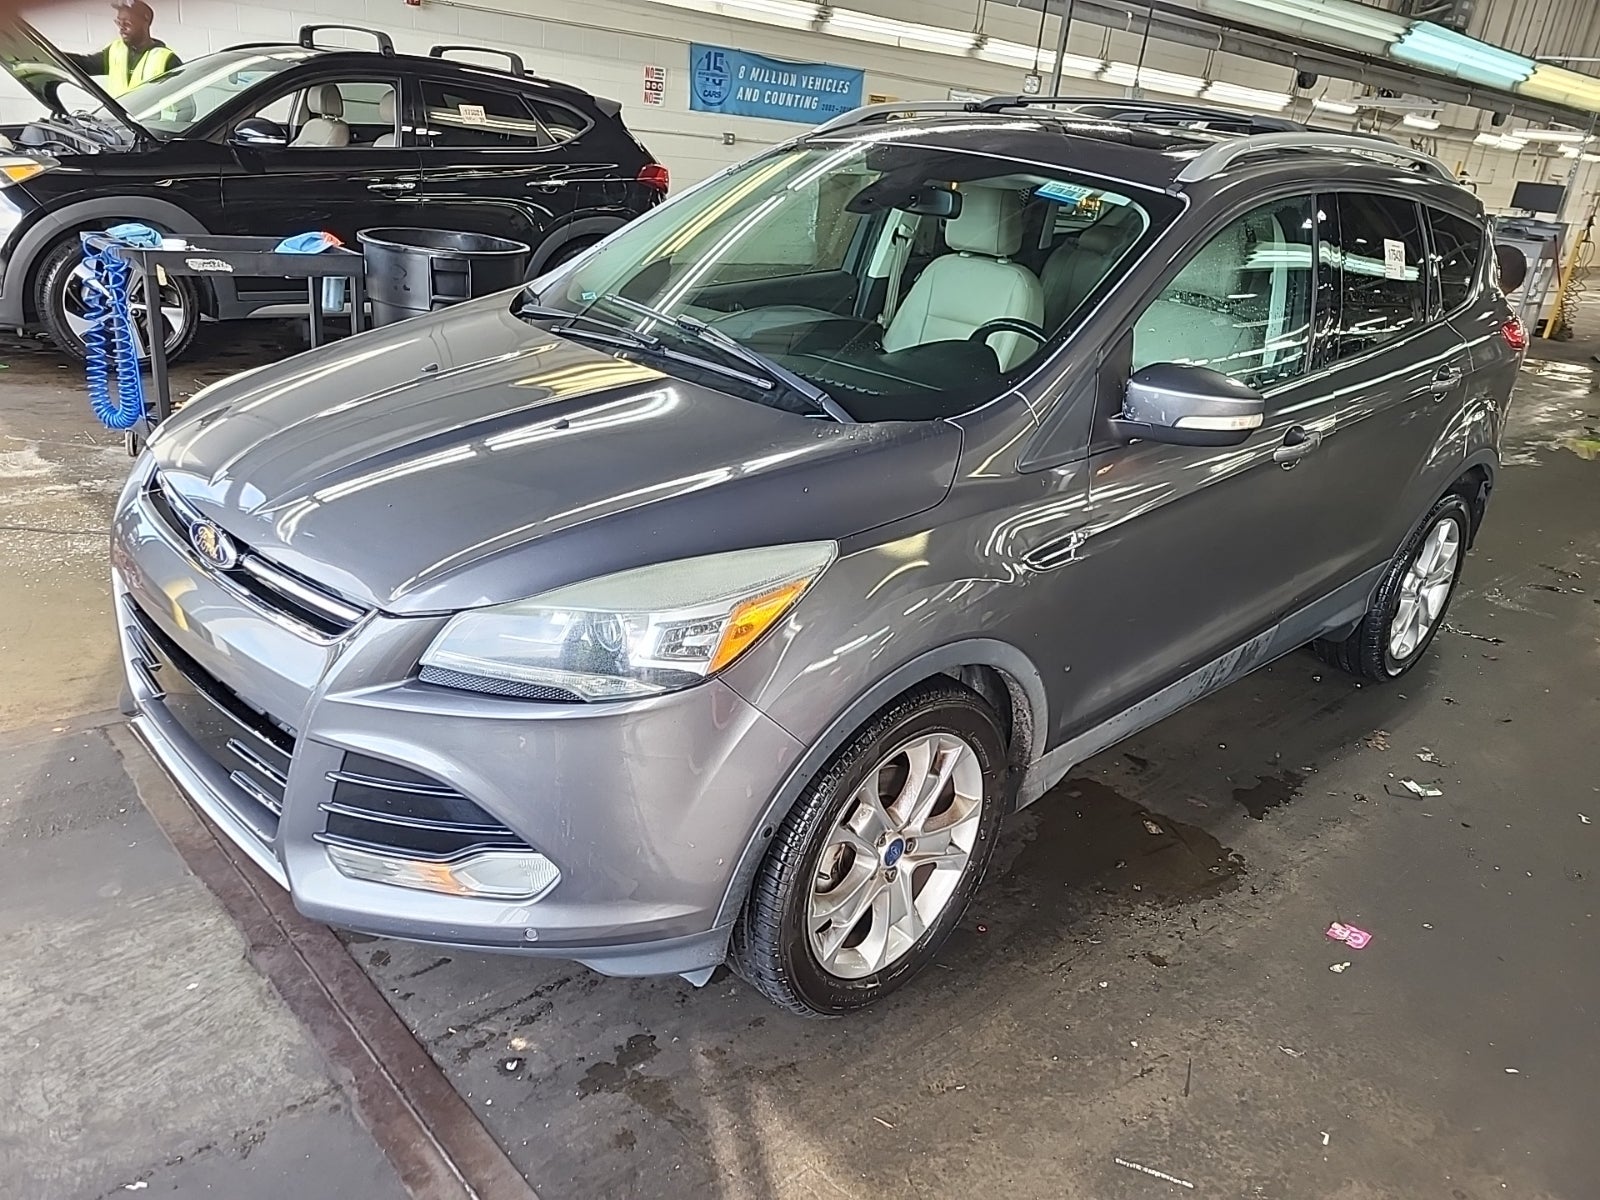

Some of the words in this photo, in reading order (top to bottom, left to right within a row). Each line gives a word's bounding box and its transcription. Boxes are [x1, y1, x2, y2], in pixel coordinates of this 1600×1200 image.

[645, 66, 655, 79] NO
[738, 65, 746, 79] 8
[749, 67, 797, 87] MILLION
[801, 75, 850, 94] VEHICLES
[644, 91, 654, 104] NO
[703, 89, 722, 98] CARS
[736, 86, 760, 102] AND
[764, 90, 819, 110] COUNTING
